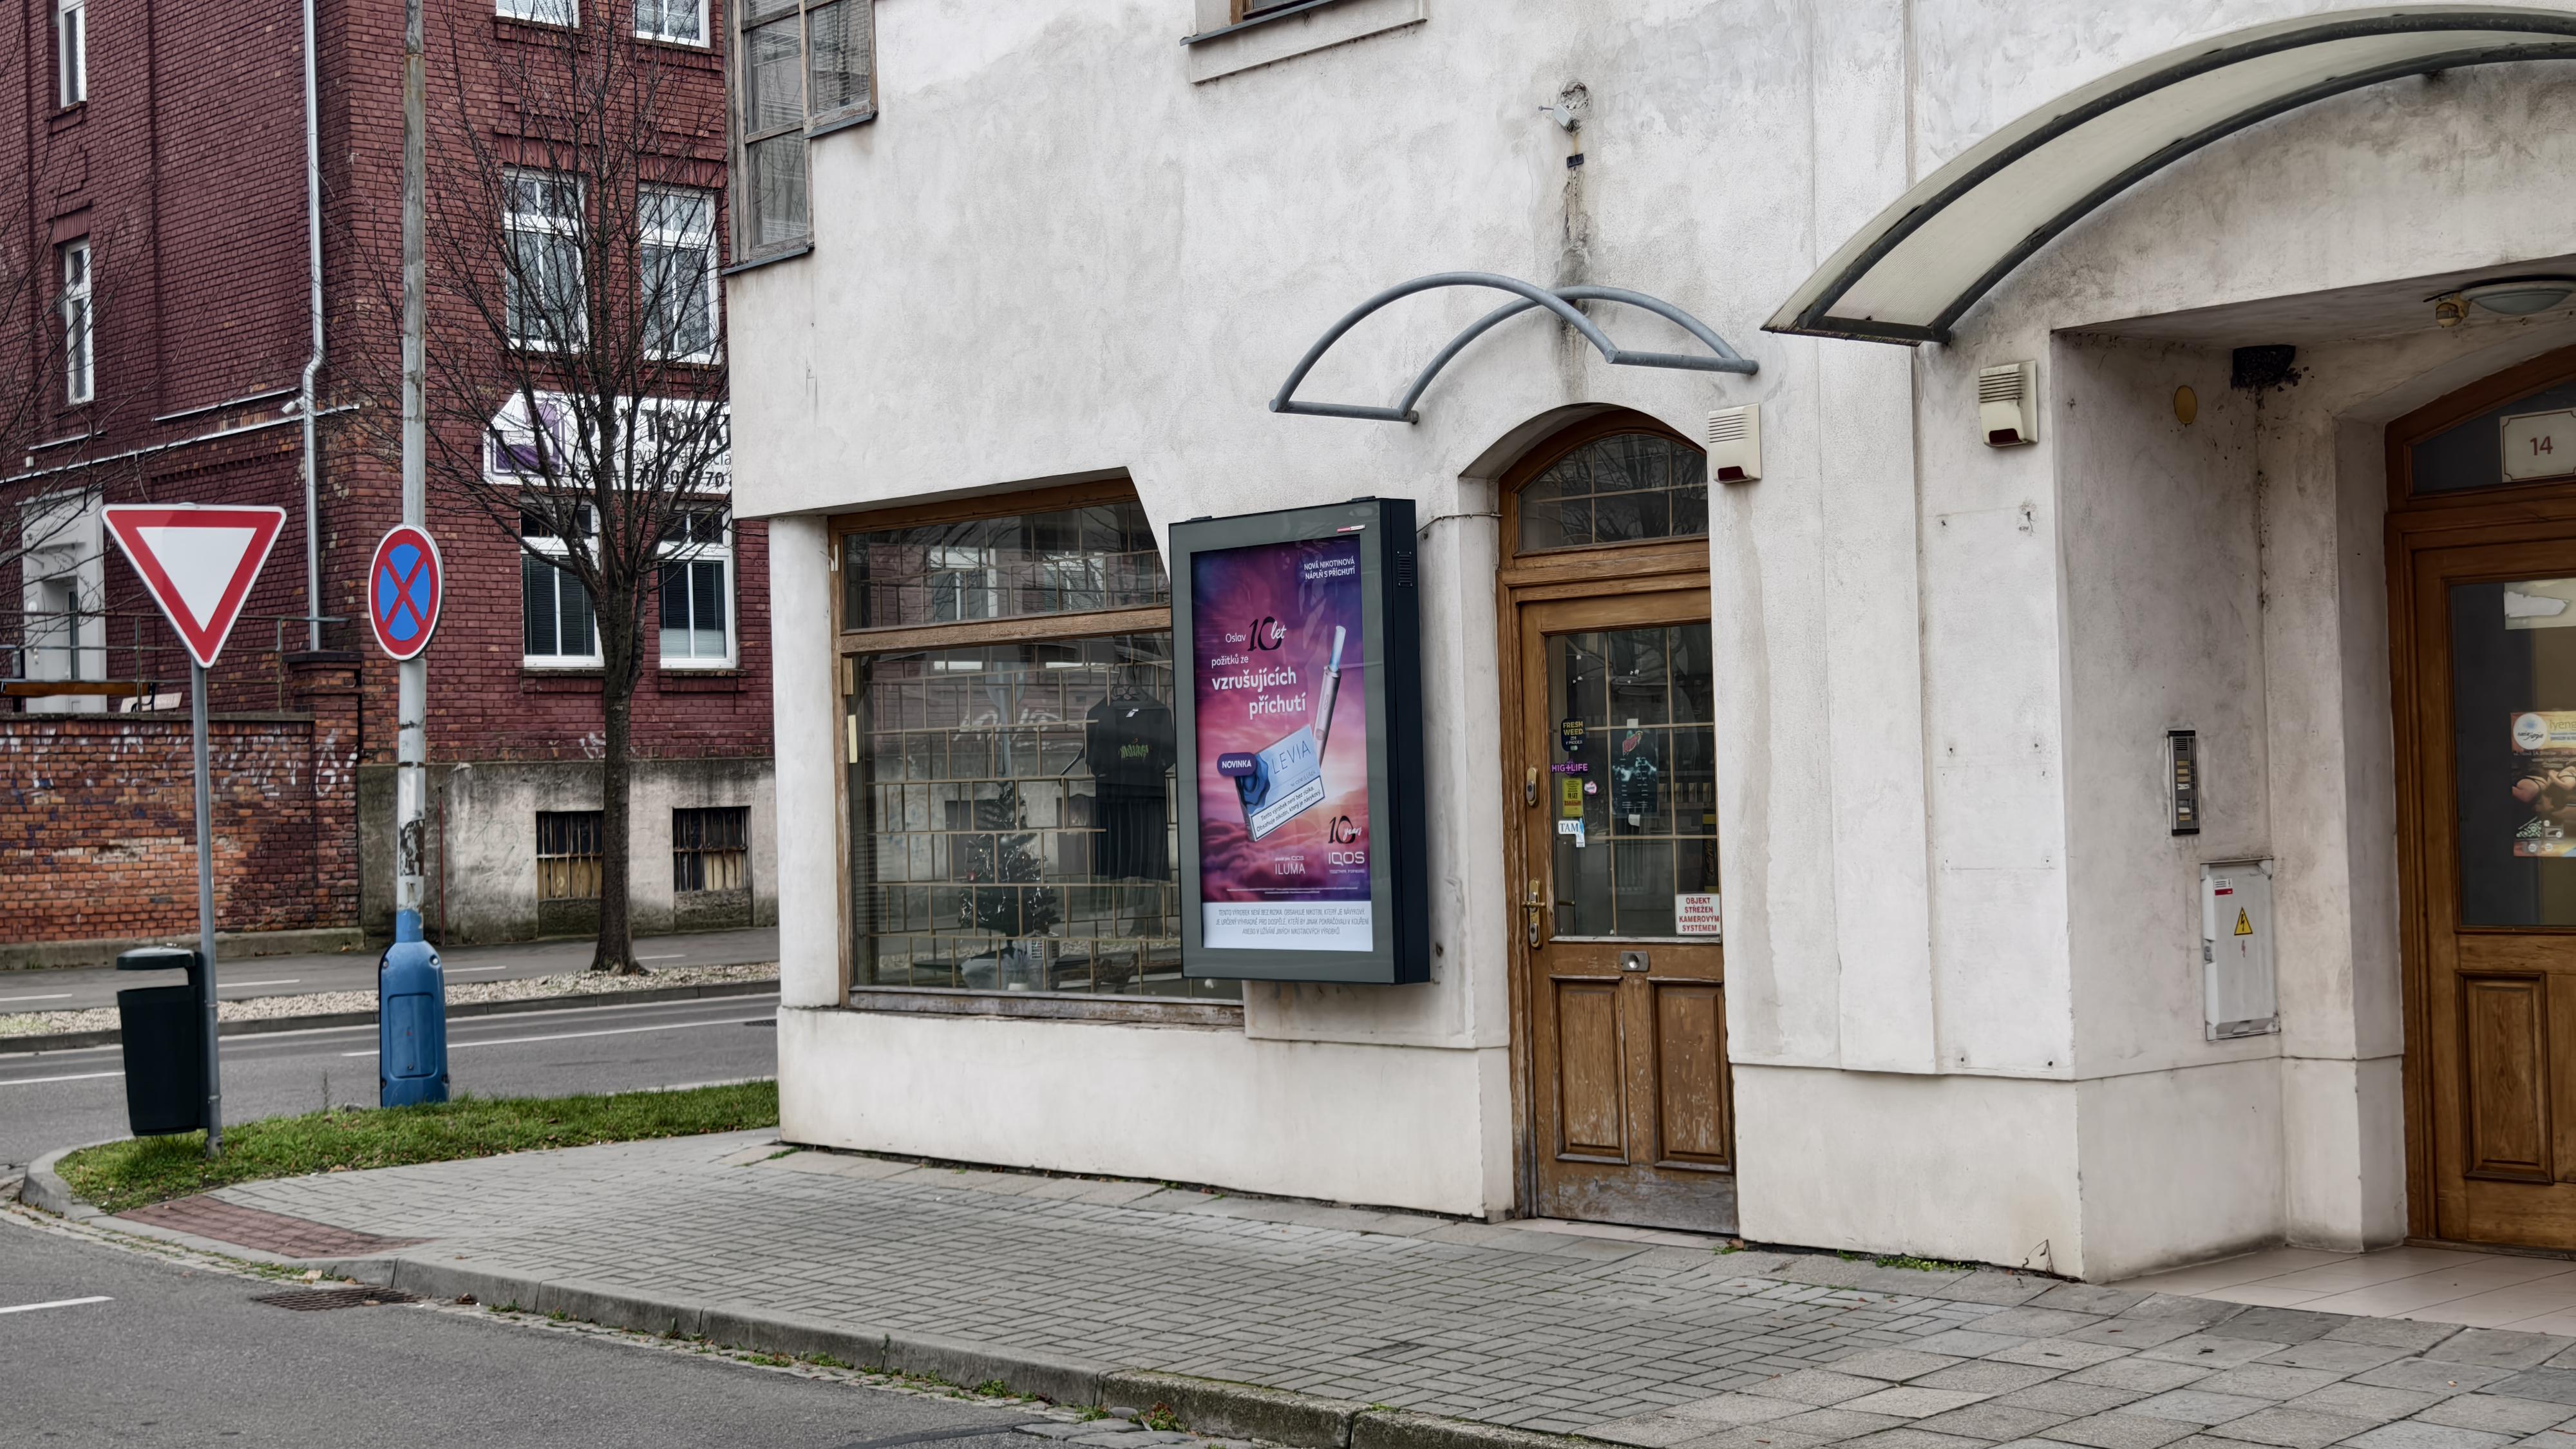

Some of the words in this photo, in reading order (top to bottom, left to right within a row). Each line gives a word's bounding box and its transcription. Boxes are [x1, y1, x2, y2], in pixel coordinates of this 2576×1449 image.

[2530, 435, 2553, 456] 14
[1304, 560, 1319, 571] NOVÁ
[1320, 555, 1355, 568] NIKOTINOVÁ
[1305, 570, 1323, 580] NÁPLŇ
[1329, 565, 1355, 577] PŘÍCHUTÍ
[1226, 632, 1246, 643] Oslav
[1247, 616, 1282, 651] 10
[1271, 621, 1287, 639] let
[1212, 653, 1239, 668] požitků
[1212, 667, 1296, 692] vzrušujících
[1249, 692, 1306, 720] příchutí
[1222, 760, 1252, 769] NOVINKA
[1272, 741, 1311, 774] LEVIA
[1328, 815, 1356, 844] 10
[1329, 851, 1365, 866] IQOS
[1275, 863, 1305, 875] ILUMA
[1685, 905, 1713, 913] STŘEŽEN
